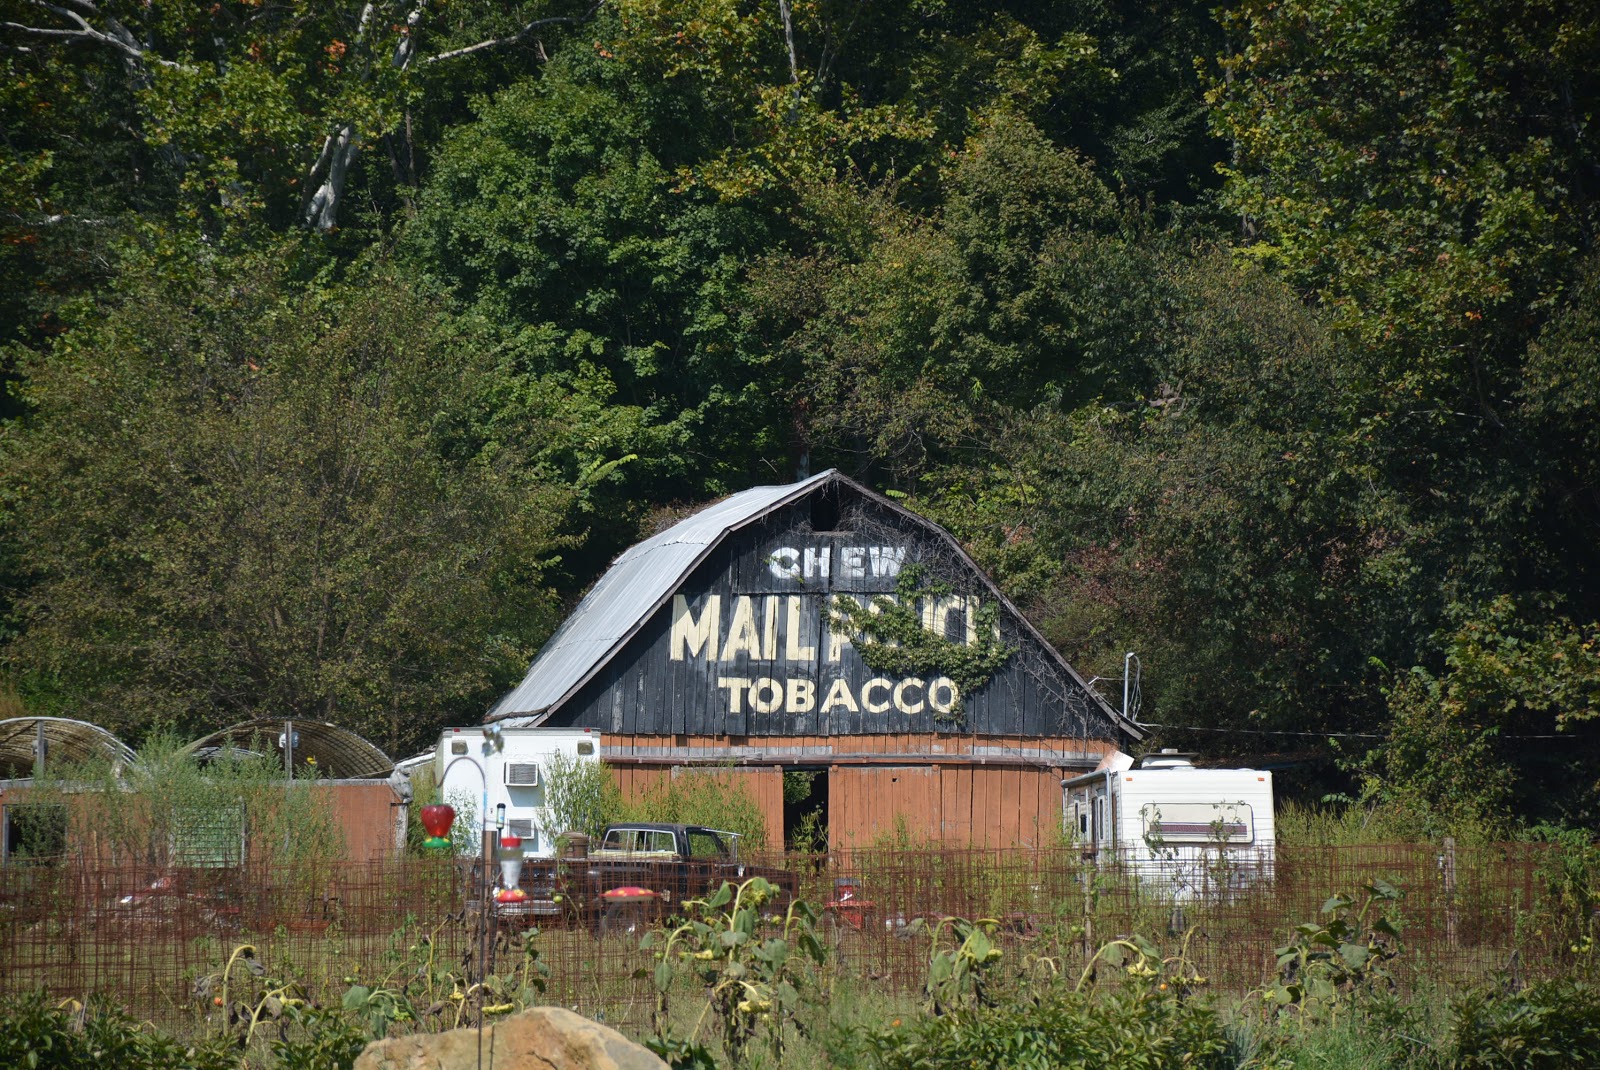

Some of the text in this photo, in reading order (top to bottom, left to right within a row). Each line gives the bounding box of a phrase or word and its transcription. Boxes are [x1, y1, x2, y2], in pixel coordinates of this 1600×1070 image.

[769, 547, 906, 578] CHEW
[669, 594, 815, 661] MAIL
[717, 677, 959, 714] TOBACCO
